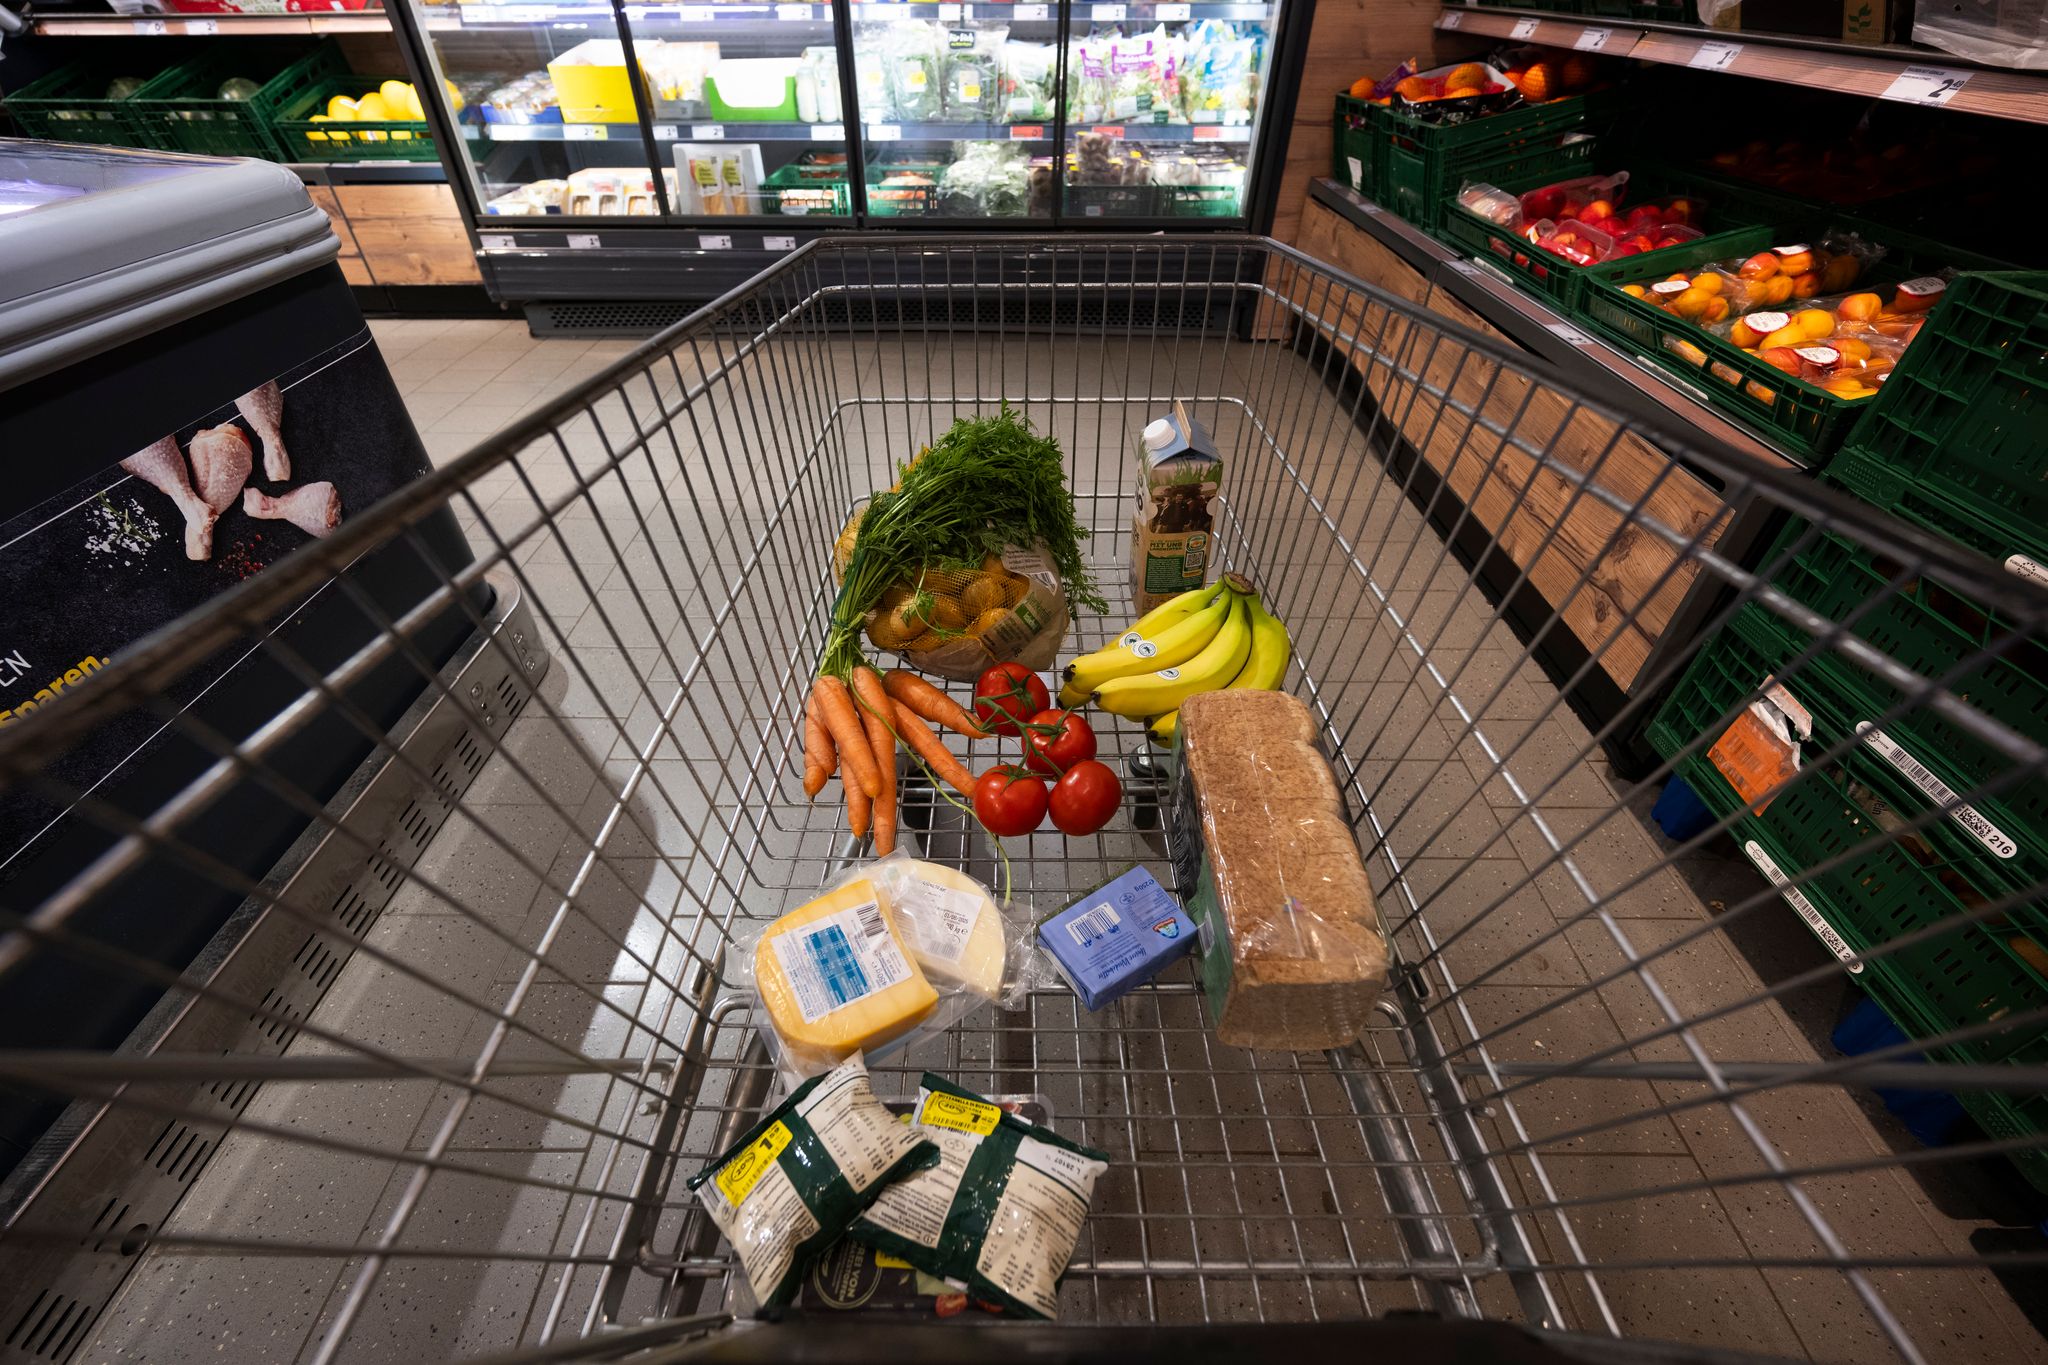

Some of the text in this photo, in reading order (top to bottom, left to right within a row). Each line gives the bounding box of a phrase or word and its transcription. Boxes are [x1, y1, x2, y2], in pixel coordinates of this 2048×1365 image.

[1927, 78, 1954, 98] 2
[1988, 833, 2013, 856] 216
[1842, 952, 1860, 970] 26
[847, 1270, 861, 1298] VON
